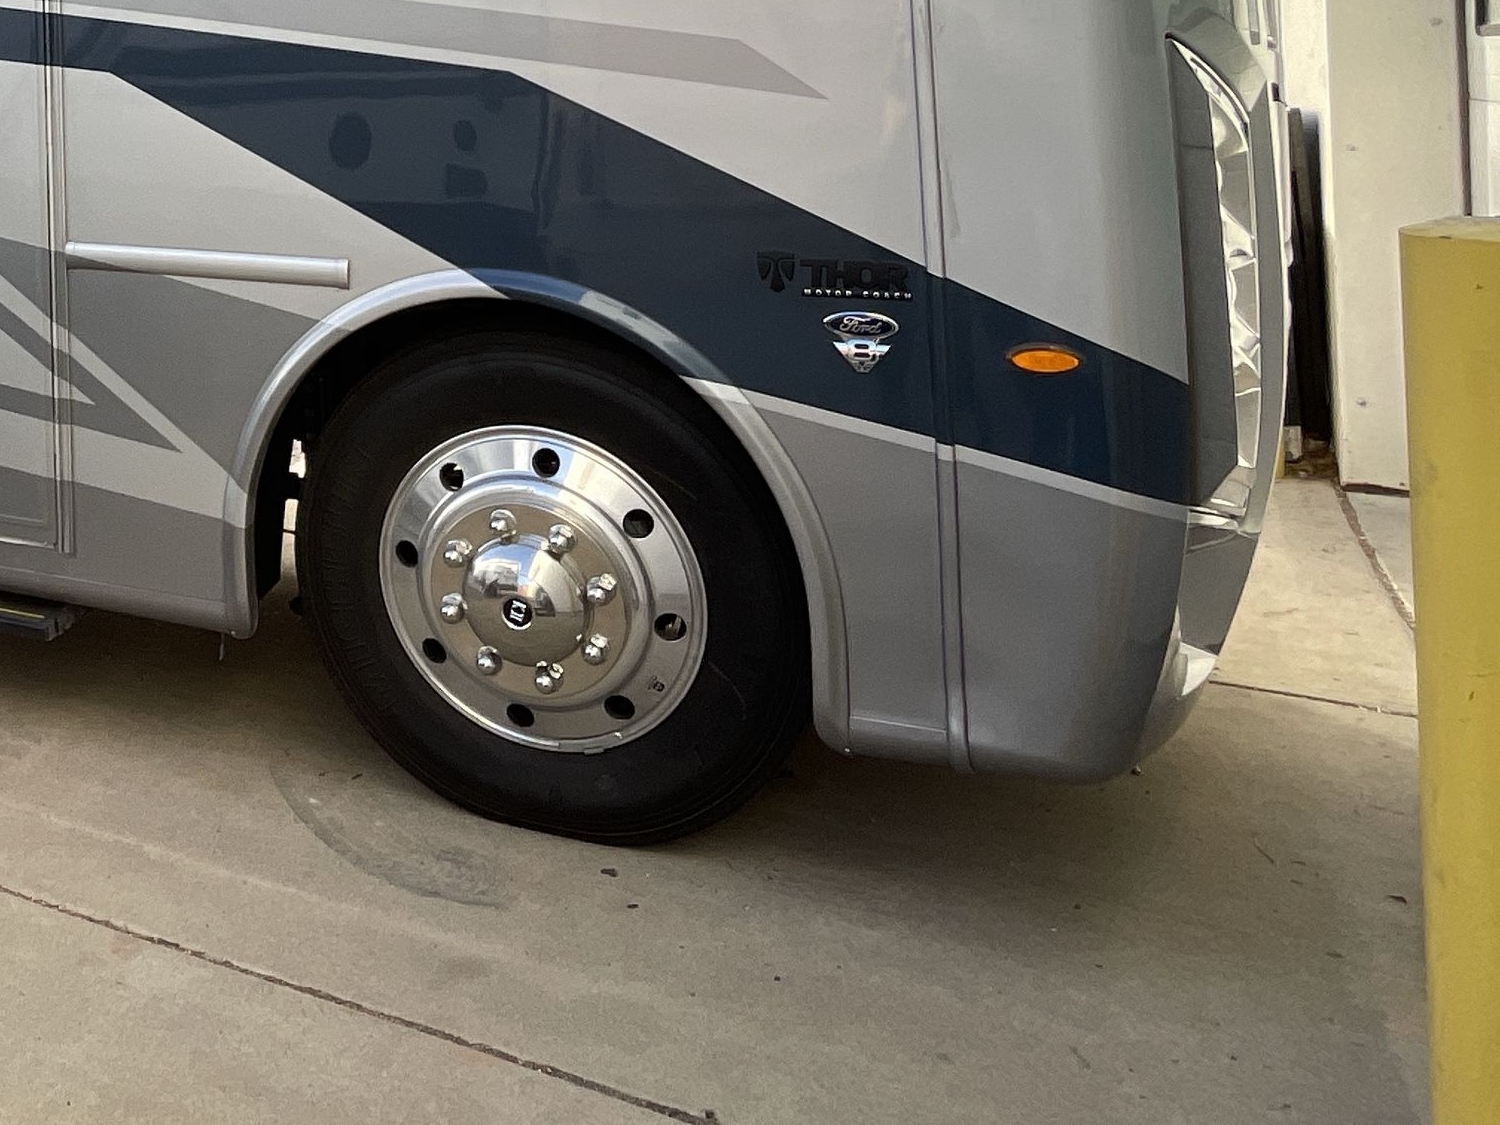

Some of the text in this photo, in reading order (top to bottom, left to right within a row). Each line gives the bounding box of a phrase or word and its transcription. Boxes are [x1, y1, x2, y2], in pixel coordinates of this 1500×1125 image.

[799, 259, 909, 291] THOR
[803, 288, 912, 299] MOTOR COACH
[840, 315, 883, 334] Ford
